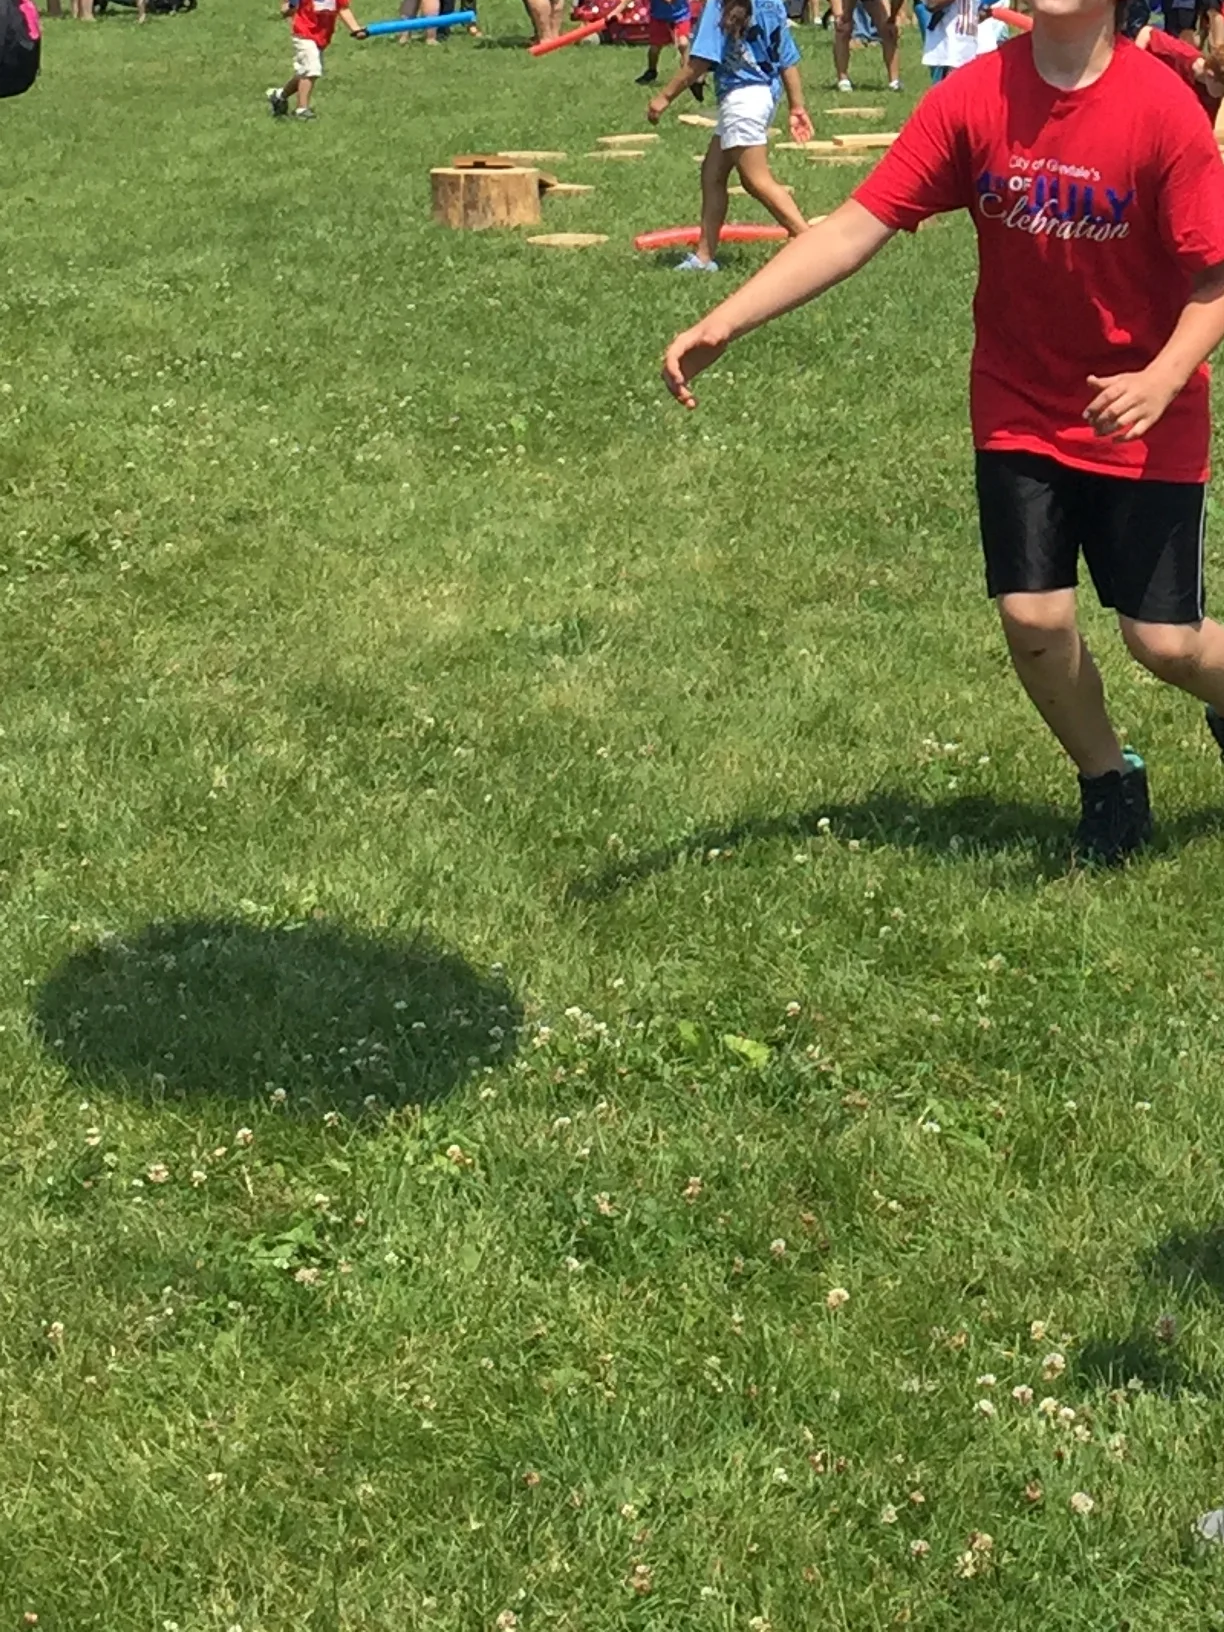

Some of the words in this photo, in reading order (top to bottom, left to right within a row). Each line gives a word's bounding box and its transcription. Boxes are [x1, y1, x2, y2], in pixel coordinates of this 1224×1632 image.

[1009, 155, 1030, 172] City
[1031, 158, 1046, 171] of
[979, 193, 1131, 242] Clebration
[1009, 175, 1033, 192] OF
[1026, 174, 1135, 225] JULY
